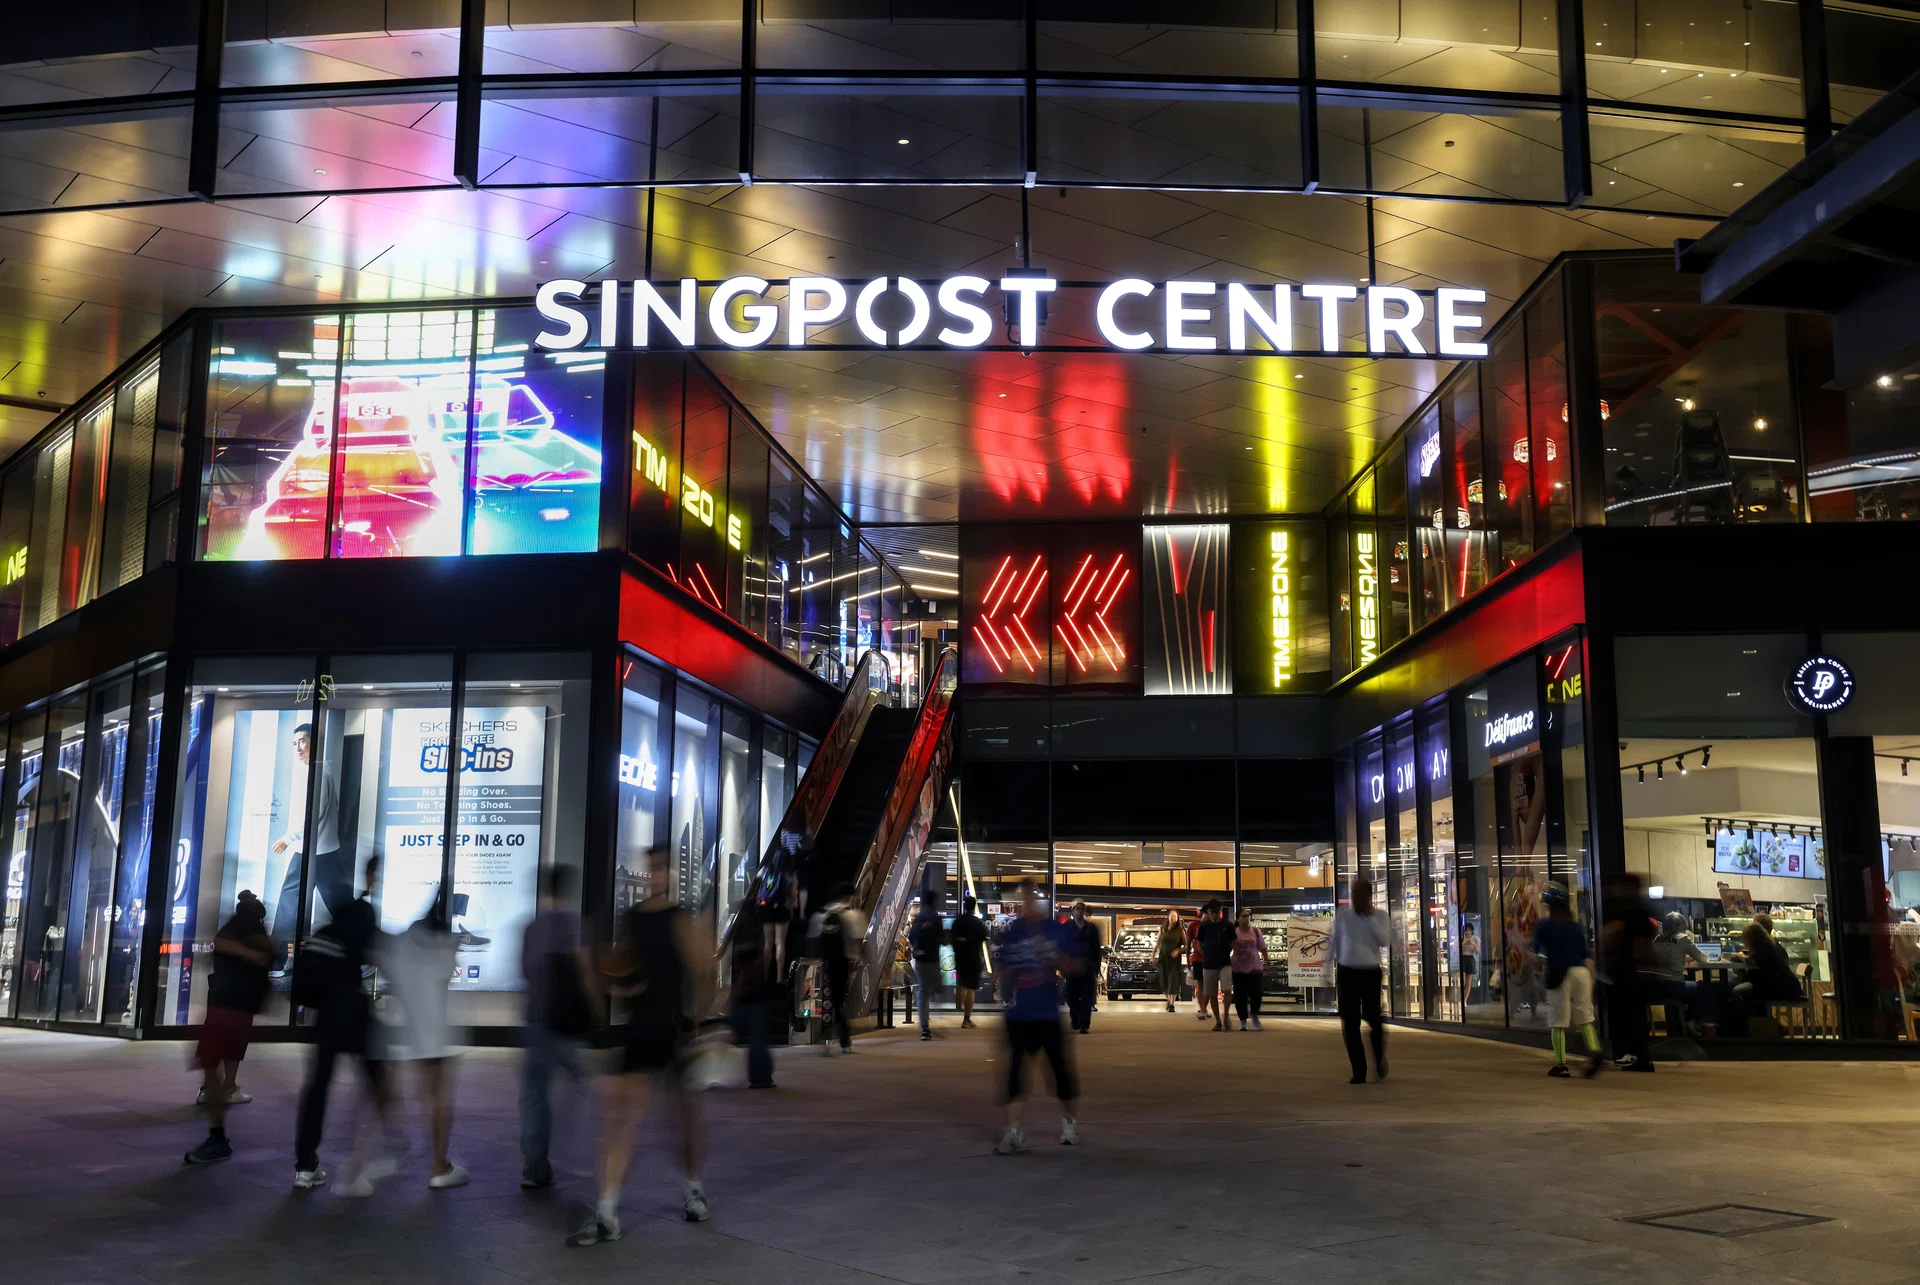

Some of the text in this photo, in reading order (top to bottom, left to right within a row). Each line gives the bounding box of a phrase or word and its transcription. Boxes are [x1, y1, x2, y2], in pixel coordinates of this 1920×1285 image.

[535, 276, 1489, 358] SINGPOST CENTRE
[632, 430, 741, 551] TIMZOE
[1271, 531, 1290, 688] TIMEZONE
[1485, 711, 1534, 747] Délifrance
[464, 734, 495, 745] FREE
[422, 787, 508, 797] No Bding Over.
[416, 801, 430, 810] No
[480, 801, 512, 809] Shoes.
[420, 815, 440, 823] Just
[469, 815, 477, 823] In
[480, 815, 487, 823] &
[490, 815, 506, 823] Go.
[400, 834, 525, 847] JUST SEP IN & GO
